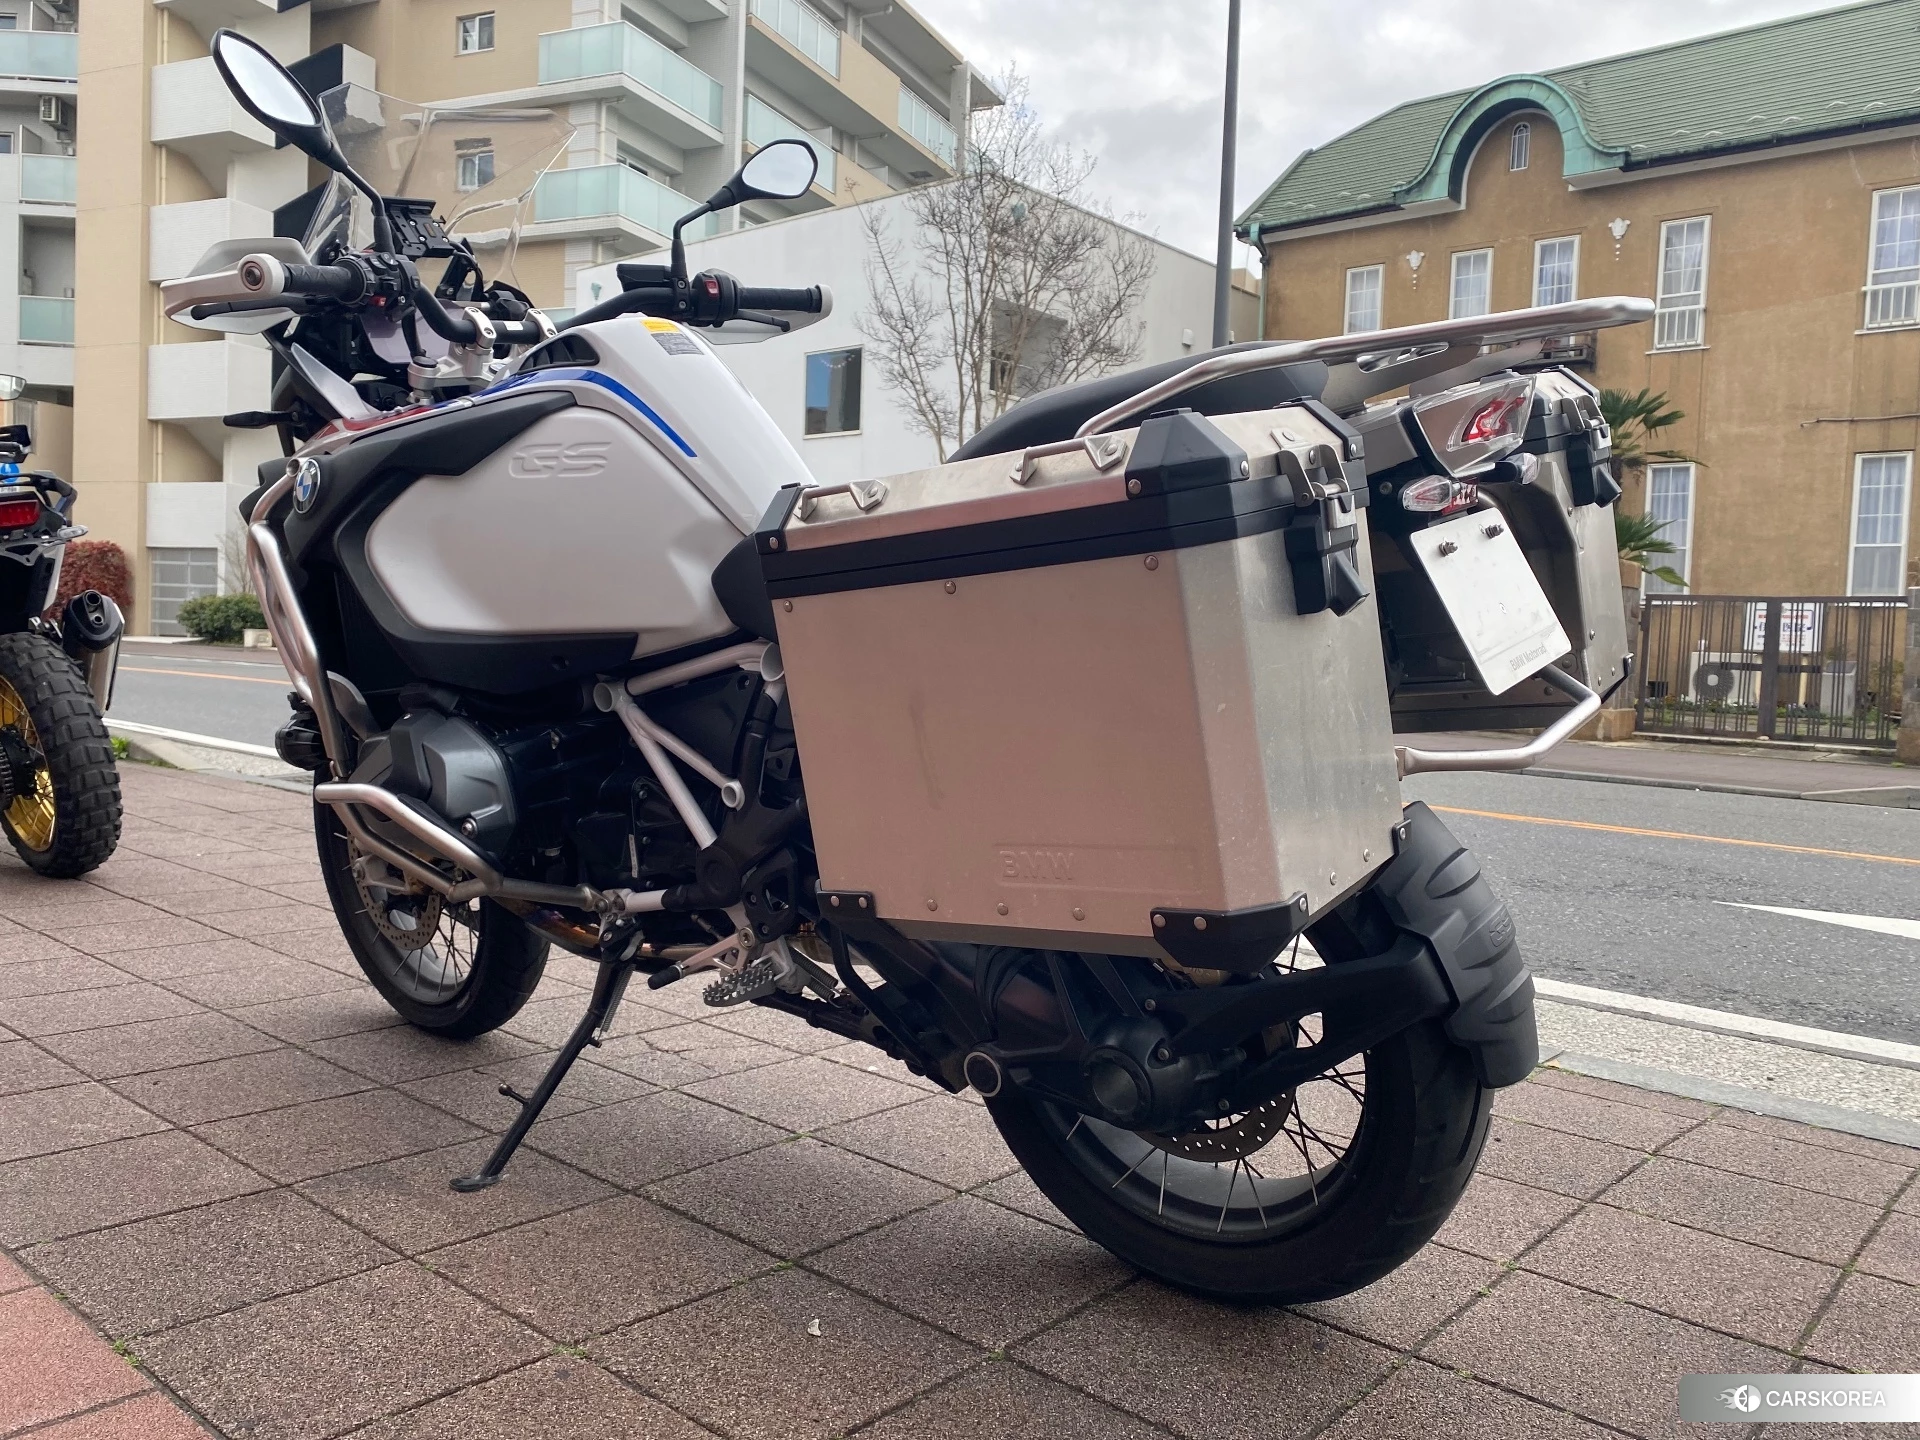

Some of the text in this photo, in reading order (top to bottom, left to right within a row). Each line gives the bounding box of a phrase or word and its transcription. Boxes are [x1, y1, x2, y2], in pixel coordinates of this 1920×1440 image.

[509, 441, 612, 479] GS
[1509, 642, 1547, 671] BMW Motorrad
[1000, 850, 1074, 880] BMW
